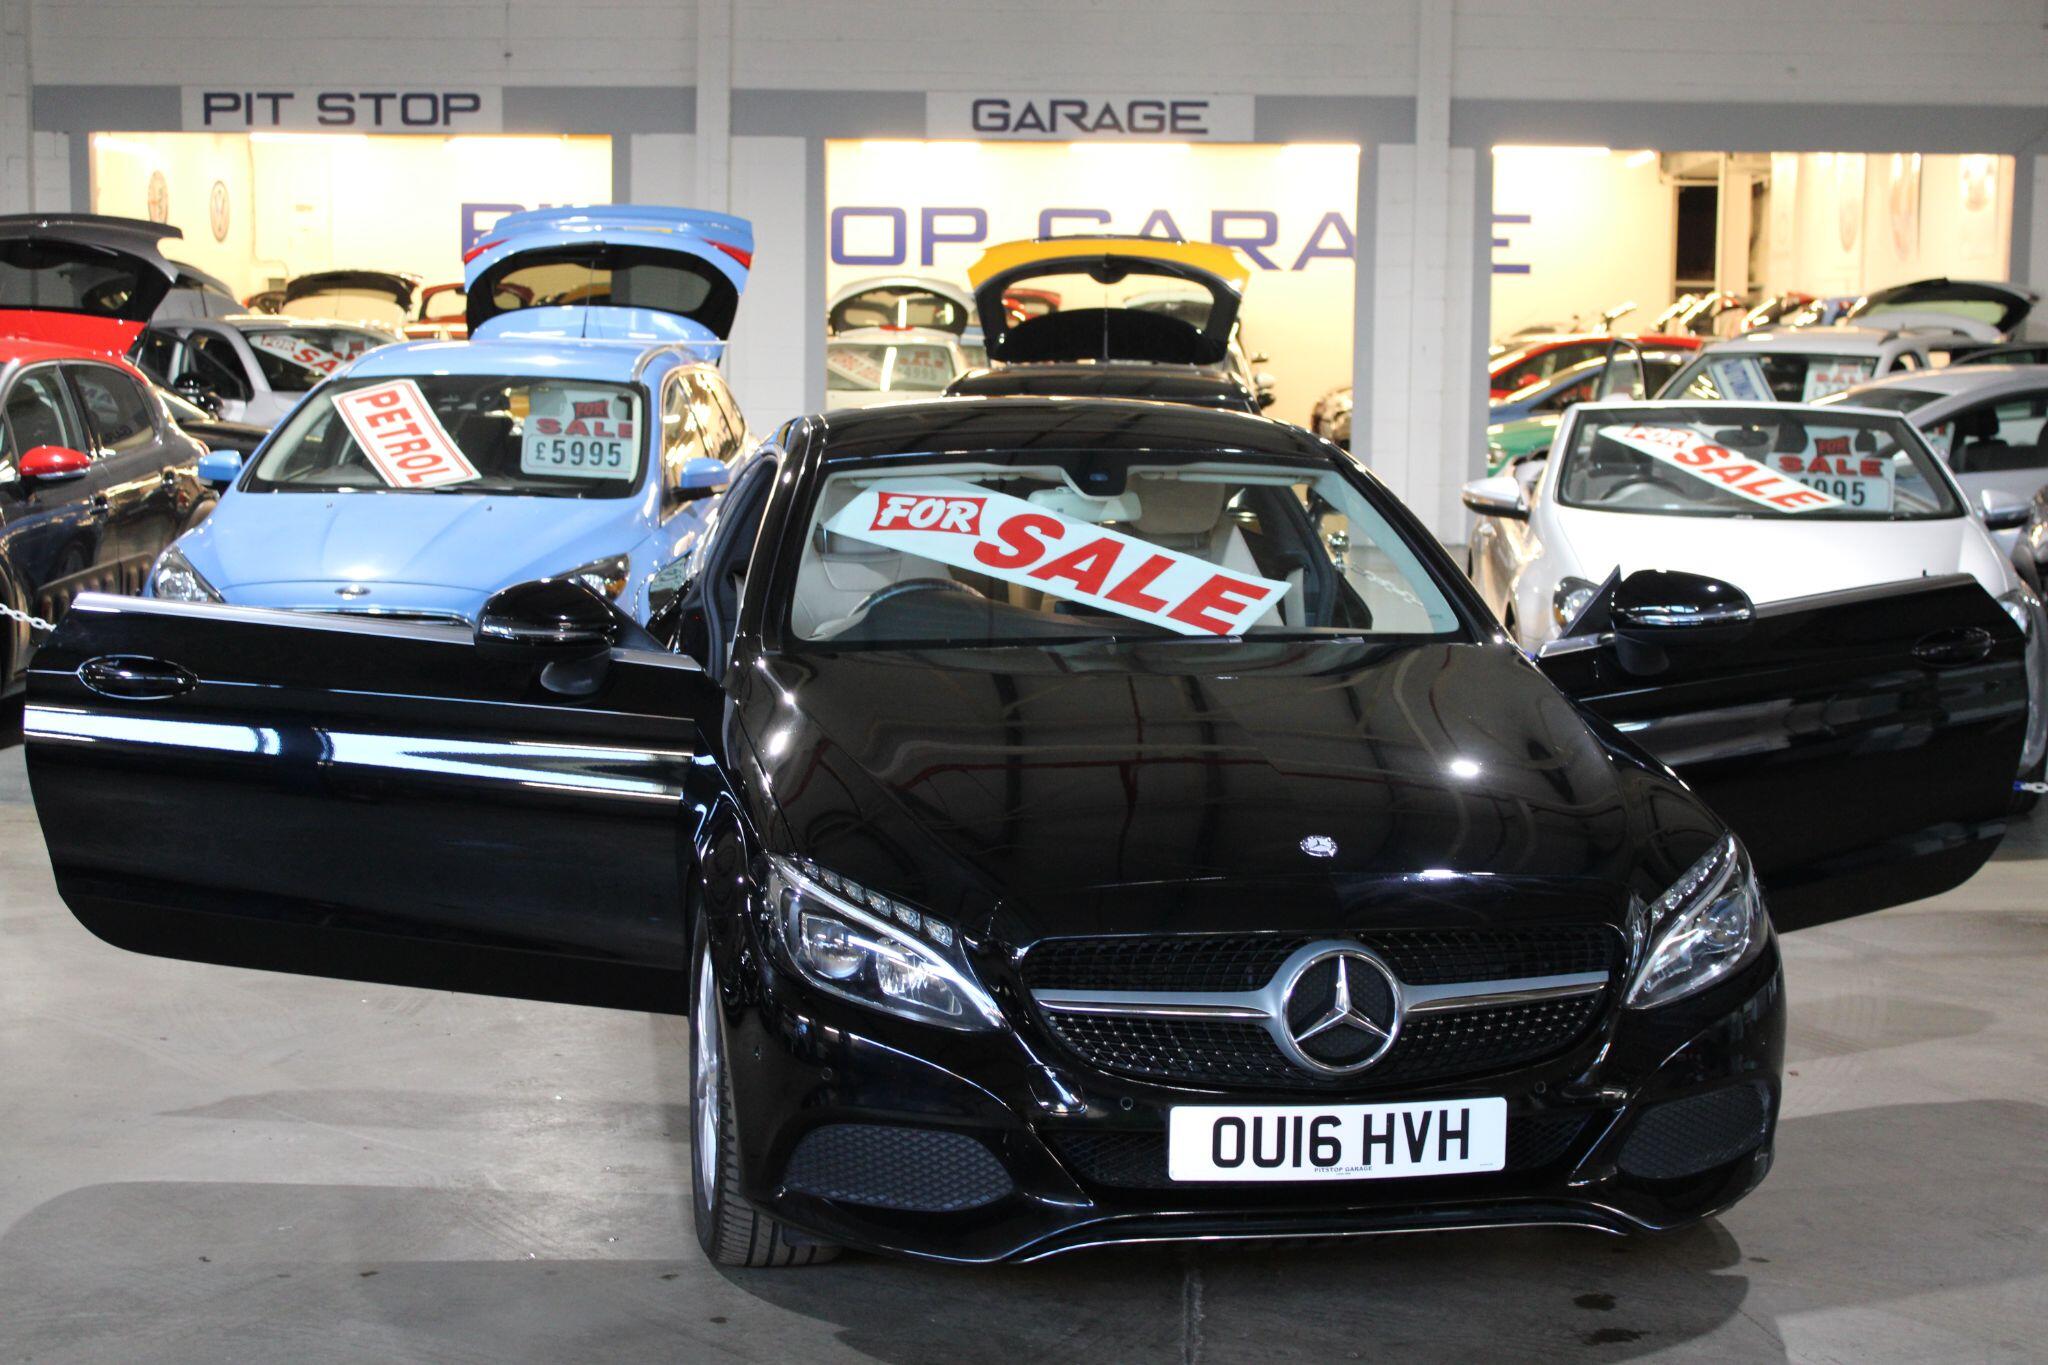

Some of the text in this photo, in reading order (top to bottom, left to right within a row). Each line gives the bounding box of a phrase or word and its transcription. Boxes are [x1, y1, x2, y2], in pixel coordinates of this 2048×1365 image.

[203, 92, 481, 126] PIT STOP
[971, 98, 1209, 134] GARAGE
[831, 206, 988, 267] OP
[293, 348, 339, 372] SA
[355, 390, 450, 482] PETROL
[536, 418, 633, 439] SALE
[1674, 445, 1826, 508] SALE
[1779, 456, 1883, 476] SALE
[870, 496, 1271, 636] FOR SALE
[1212, 1108, 1470, 1168] OU16 HVH
